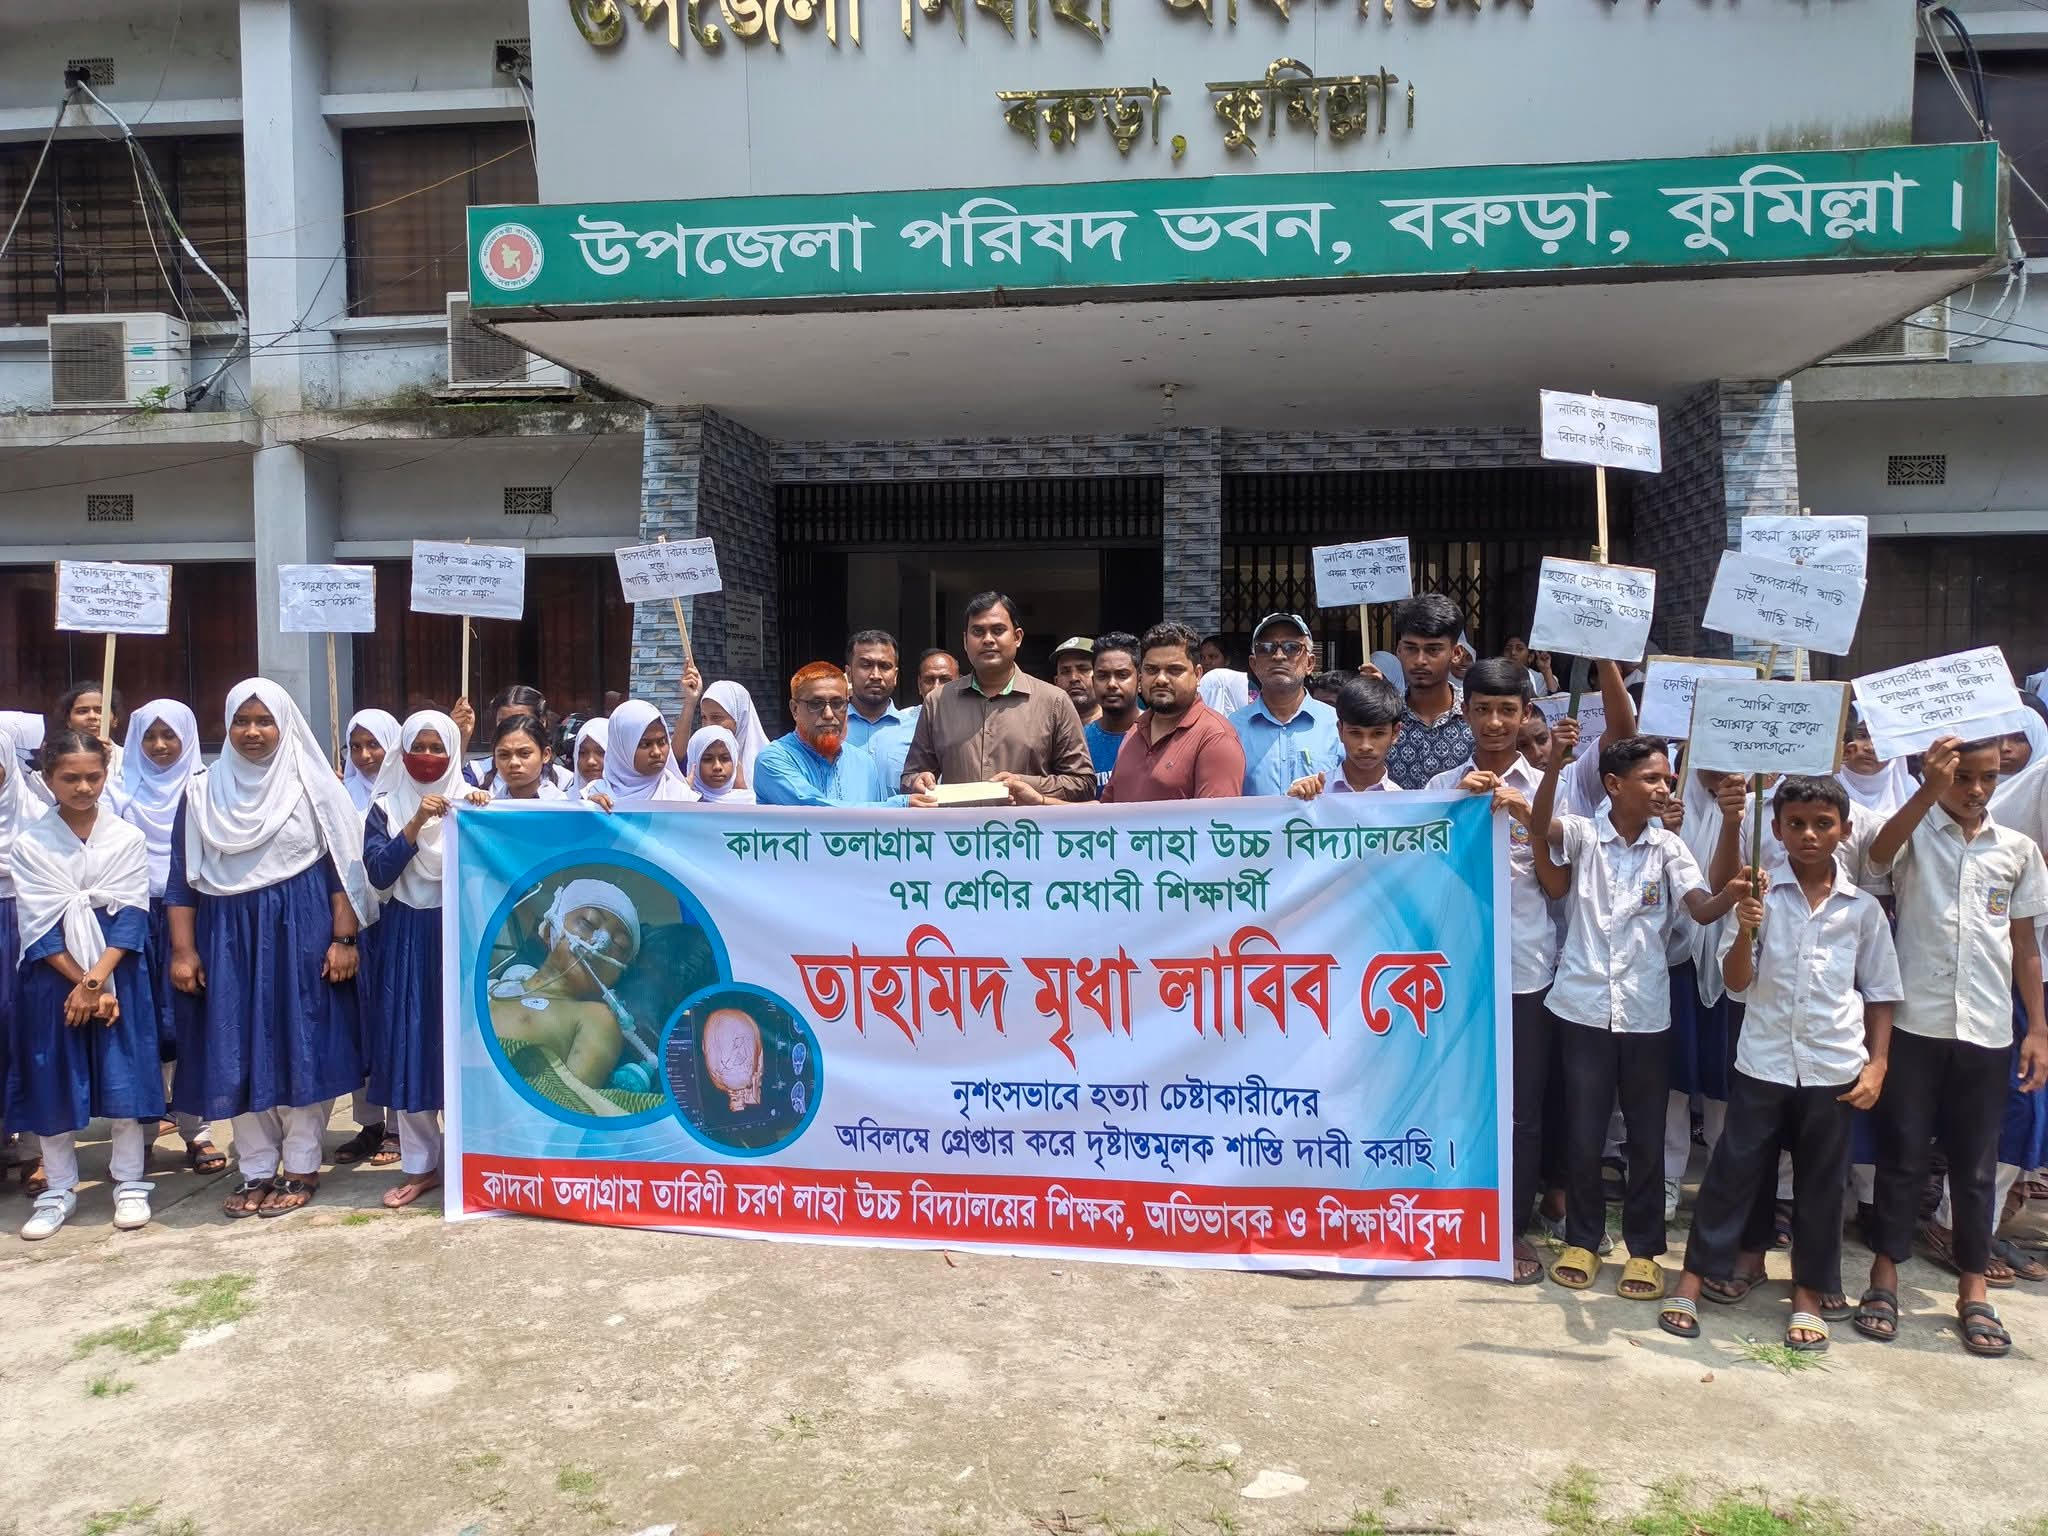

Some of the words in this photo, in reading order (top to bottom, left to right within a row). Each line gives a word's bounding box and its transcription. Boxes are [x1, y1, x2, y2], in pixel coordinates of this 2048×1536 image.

[570, 214, 876, 277] উপজেলা
[900, 197, 1138, 268] পরিষদ
[1154, 201, 1352, 265] ভবন,
[1380, 184, 1630, 255] বরুড়া,
[1658, 165, 1920, 256] কুমিল্লা
[1586, 596, 1614, 615] শাস্তি
[1750, 572, 1809, 597] অপরাধীর
[1816, 588, 1847, 606] শাস্তি
[1757, 608, 1789, 626] শাস্তি
[1937, 658, 1972, 675] শাস্তি
[1709, 717, 1756, 734] আমার
[723, 828, 811, 862] কাদবা
[820, 827, 935, 863] তলাগ্রাম
[944, 819, 1043, 861] তারিণী
[1053, 826, 1118, 861] চরণ
[1127, 826, 1197, 866] লাহা
[1208, 819, 1272, 859] উচ্চ
[1282, 818, 1454, 860] বিদ্যালয়ের
[889, 880, 932, 910] ৭ম
[945, 869, 1032, 912] শ্রেণির
[1046, 868, 1144, 912] মেধাবী
[1154, 868, 1274, 913] শিক্ষার্থী
[791, 923, 1011, 1051] তাহমিদ
[1021, 944, 1142, 1070] মৃধা
[1151, 924, 1339, 1039] লাবিব
[1359, 951, 1453, 1039] কে
[951, 1077, 1081, 1120] নৃশংসভাবে
[1088, 1080, 1149, 1114] হত্যা
[1160, 1074, 1321, 1118] চেষ্টাকারীদের
[834, 1116, 930, 1154] অবিলম্বে
[941, 1126, 1015, 1158] গ্রেপ্তার
[1021, 1129, 1076, 1158] করে
[1084, 1120, 1214, 1173] দৃষ্টান্তমূলক
[1222, 1127, 1284, 1168] শাস্তি
[1292, 1127, 1352, 1169] দাবী
[1360, 1127, 1436, 1172] করছি
[481, 1169, 545, 1209] কাদবা
[551, 1171, 643, 1213] তলাগ্রাম
[649, 1168, 728, 1216] তারিণী
[734, 1179, 784, 1218] চরণ
[792, 1181, 847, 1224] লাহা
[853, 1178, 903, 1222] উচ্চ
[909, 1177, 1038, 1229] বিদ্যালয়ের
[1045, 1183, 1135, 1243] শিক্ষক,
[1142, 1190, 1274, 1239] অভিভাবক
[1284, 1204, 1308, 1238] ও
[1316, 1193, 1465, 1260] শিক্ষার্থীবৃন্দ
